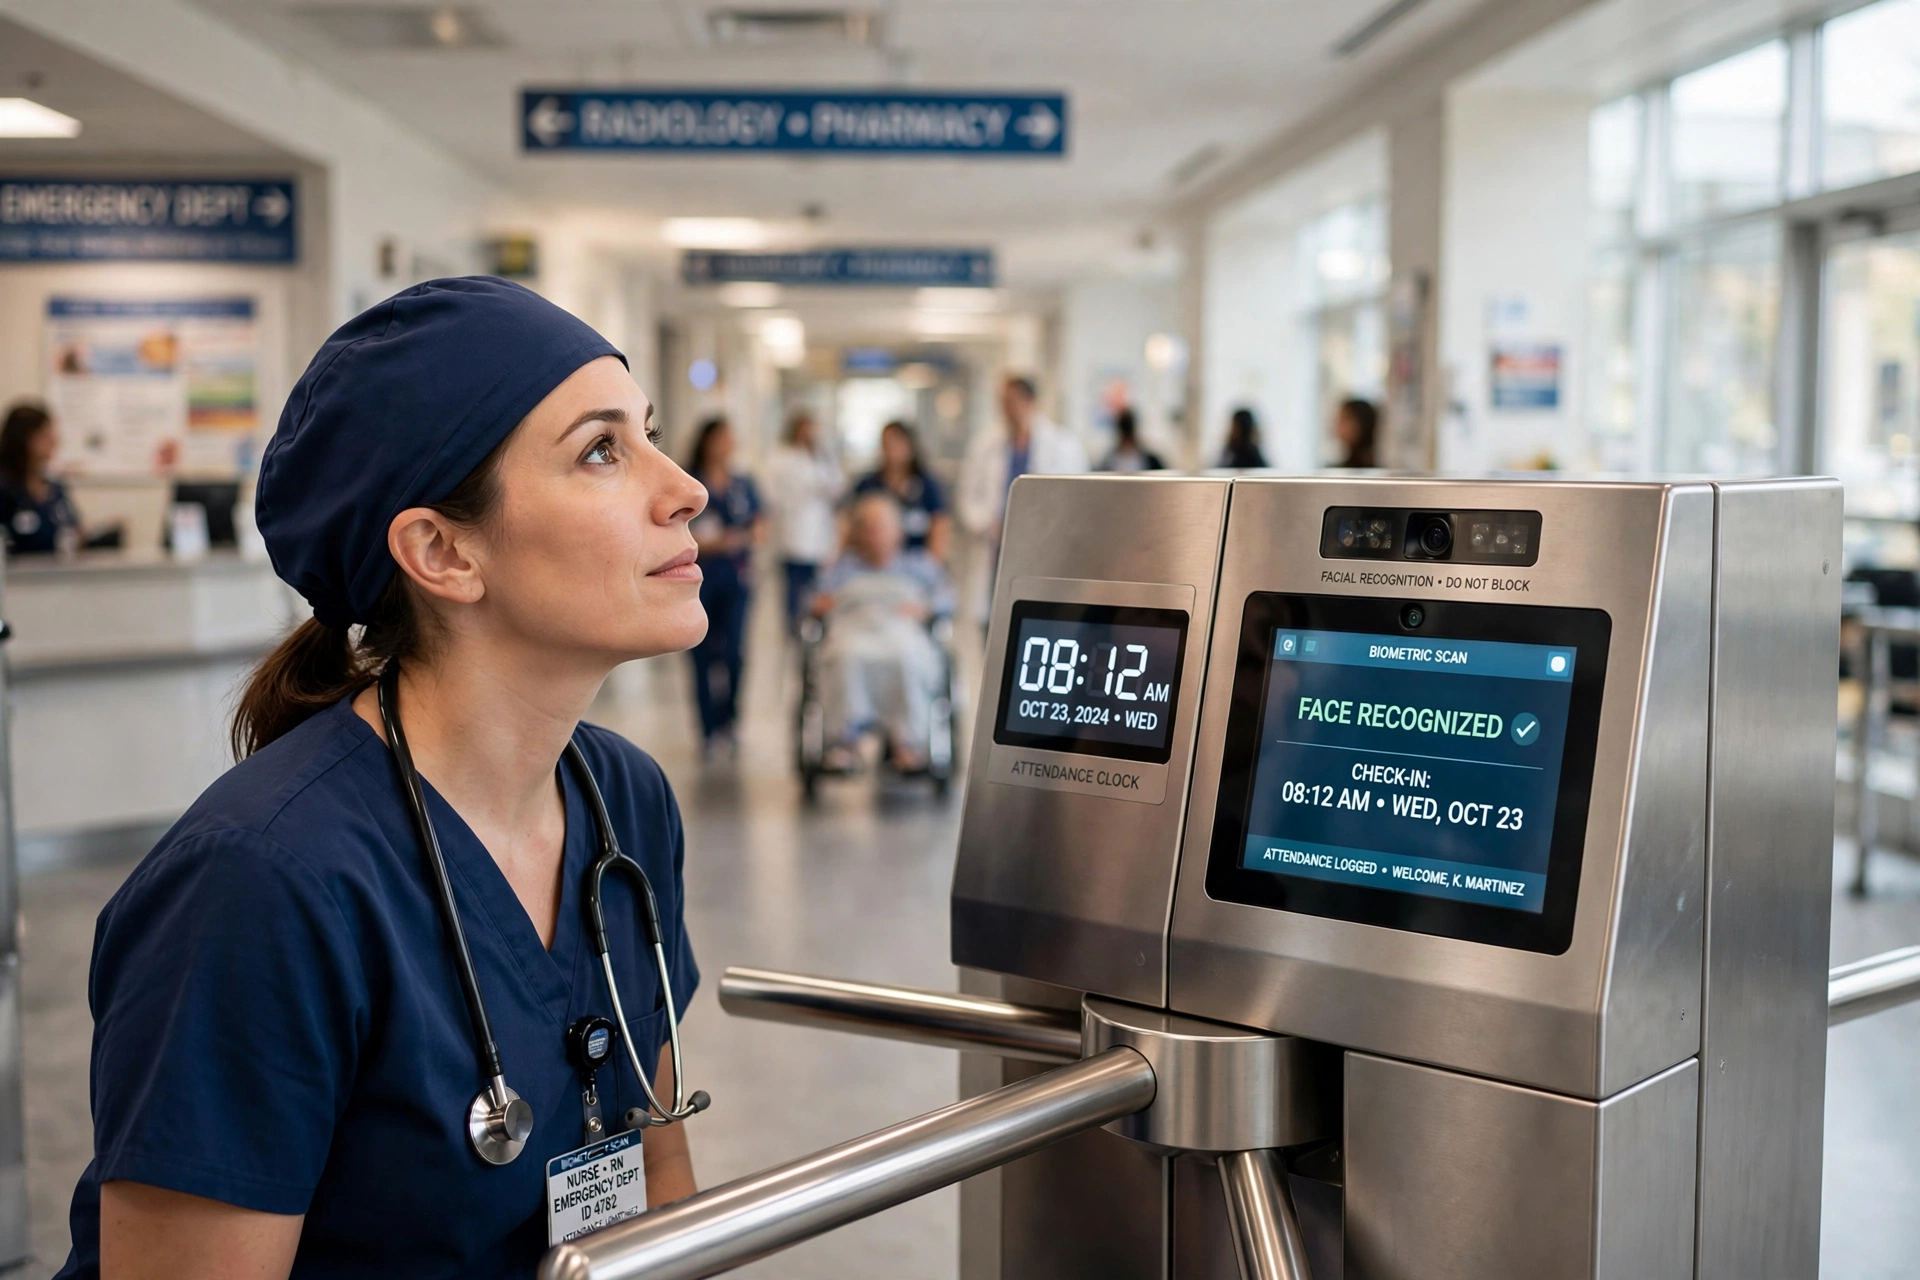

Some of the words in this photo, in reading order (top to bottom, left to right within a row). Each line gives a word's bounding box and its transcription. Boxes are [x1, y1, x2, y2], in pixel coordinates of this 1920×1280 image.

[580, 100, 785, 145] RADIOLOGY
[811, 101, 1011, 147] PHARMACY
[1, 184, 169, 225] EMERGENCY
[173, 185, 249, 226] DEPT
[1321, 571, 1357, 584] FACIAL
[1359, 573, 1434, 588] RECOGNITION
[1446, 577, 1463, 589] DO
[1465, 578, 1489, 590] NOT
[1491, 579, 1531, 592] BLOCK
[1018, 636, 1148, 701] 08:12
[1143, 682, 1170, 703] AM
[1369, 645, 1433, 662] BIOMETRIC
[1435, 650, 1468, 664] SCAN
[1019, 699, 1049, 719] OCT
[1050, 702, 1071, 725] 23,
[1073, 705, 1110, 726] 2024
[1125, 710, 1158, 731] WED
[1298, 697, 1353, 725] FACE
[1356, 702, 1504, 739] RECOGNIZED
[1011, 761, 1094, 784] ATTENDANCE
[1096, 770, 1141, 790] CLOCK
[1351, 763, 1432, 789] CHECK-IN:
[1282, 781, 1334, 808] 08:12
[1337, 788, 1371, 812] AM
[1391, 794, 1442, 825] WED,
[1447, 801, 1494, 827] OCT
[1496, 806, 1524, 831] 23
[1263, 848, 1333, 869] ATTENDANCE
[1334, 856, 1378, 875] LOGGED
[1391, 865, 1450, 888] WELCOME,
[1452, 873, 1463, 888] K.
[1465, 875, 1526, 897] MARTINEZ
[554, 1176, 614, 1214] EMERGENCY
[616, 1167, 640, 1188] DEPT
[567, 1164, 600, 1190] NURSE
[610, 1155, 624, 1173] RN
[581, 1205, 592, 1221] ID
